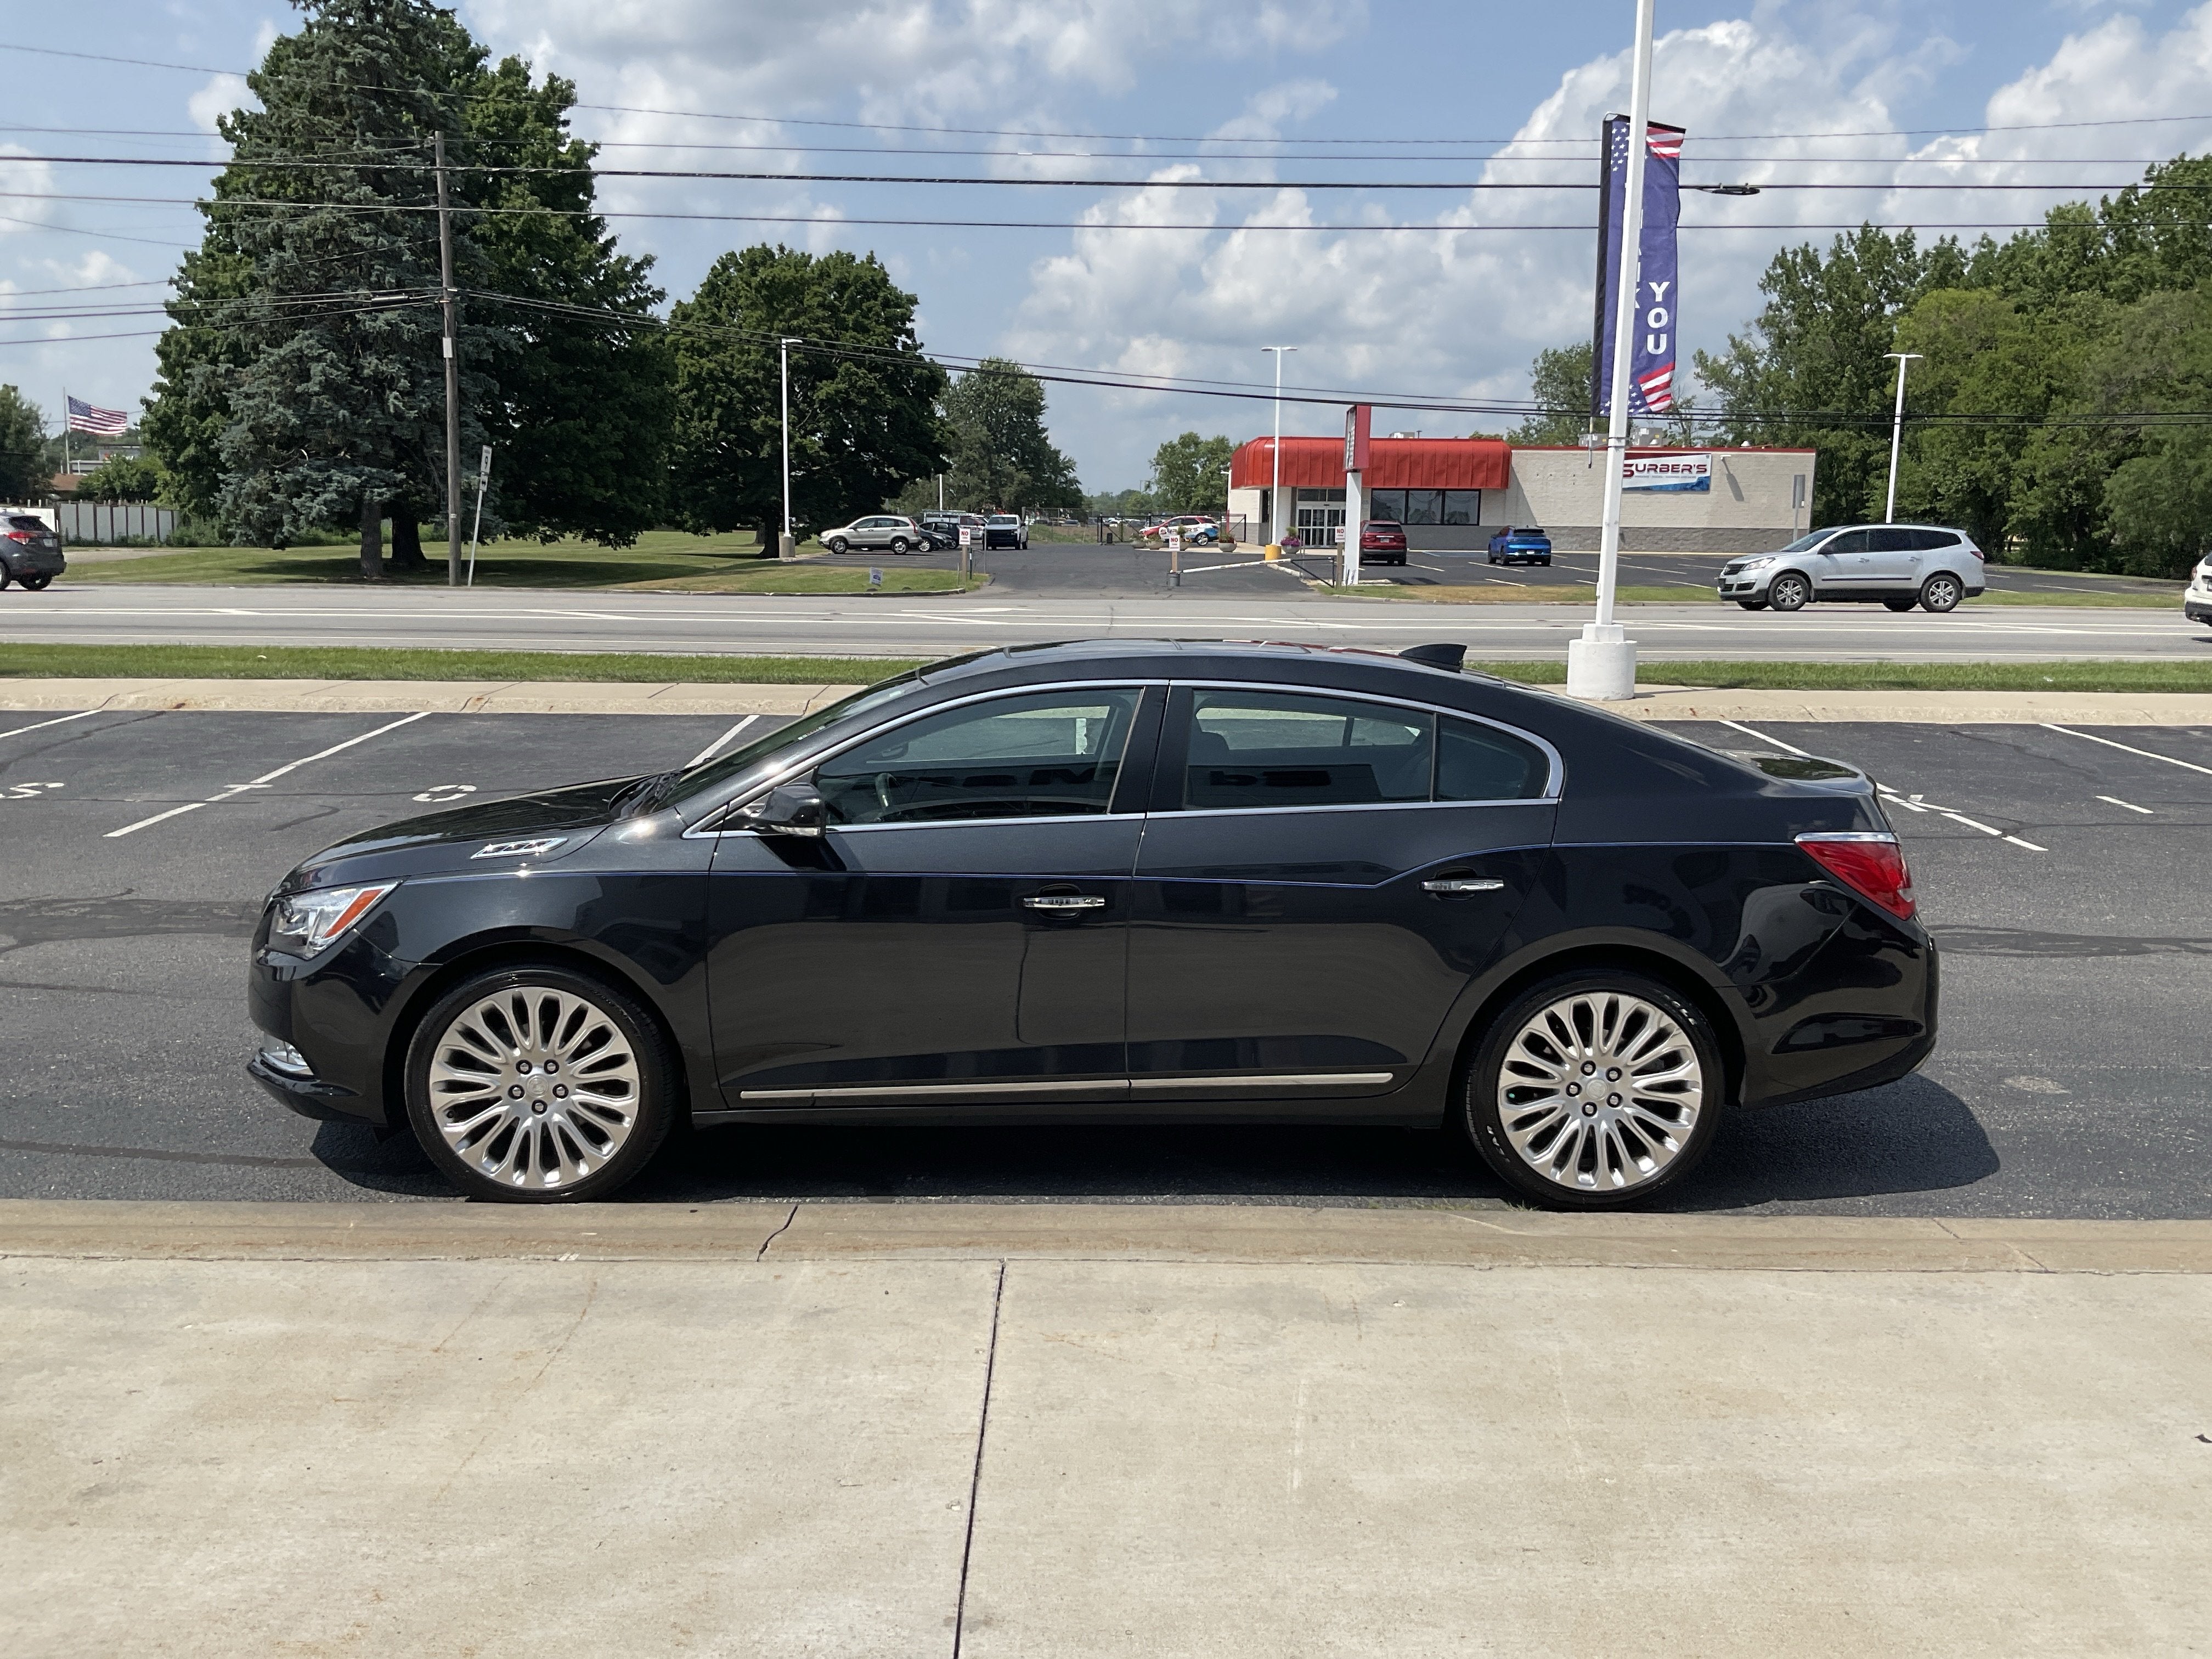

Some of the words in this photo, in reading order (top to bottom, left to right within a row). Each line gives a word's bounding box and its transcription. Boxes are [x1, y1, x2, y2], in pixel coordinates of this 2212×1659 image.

[1647, 281, 1671, 355] YOU
[484, 456, 489, 469] 9
[1623, 463, 1707, 478] SURBER'S
